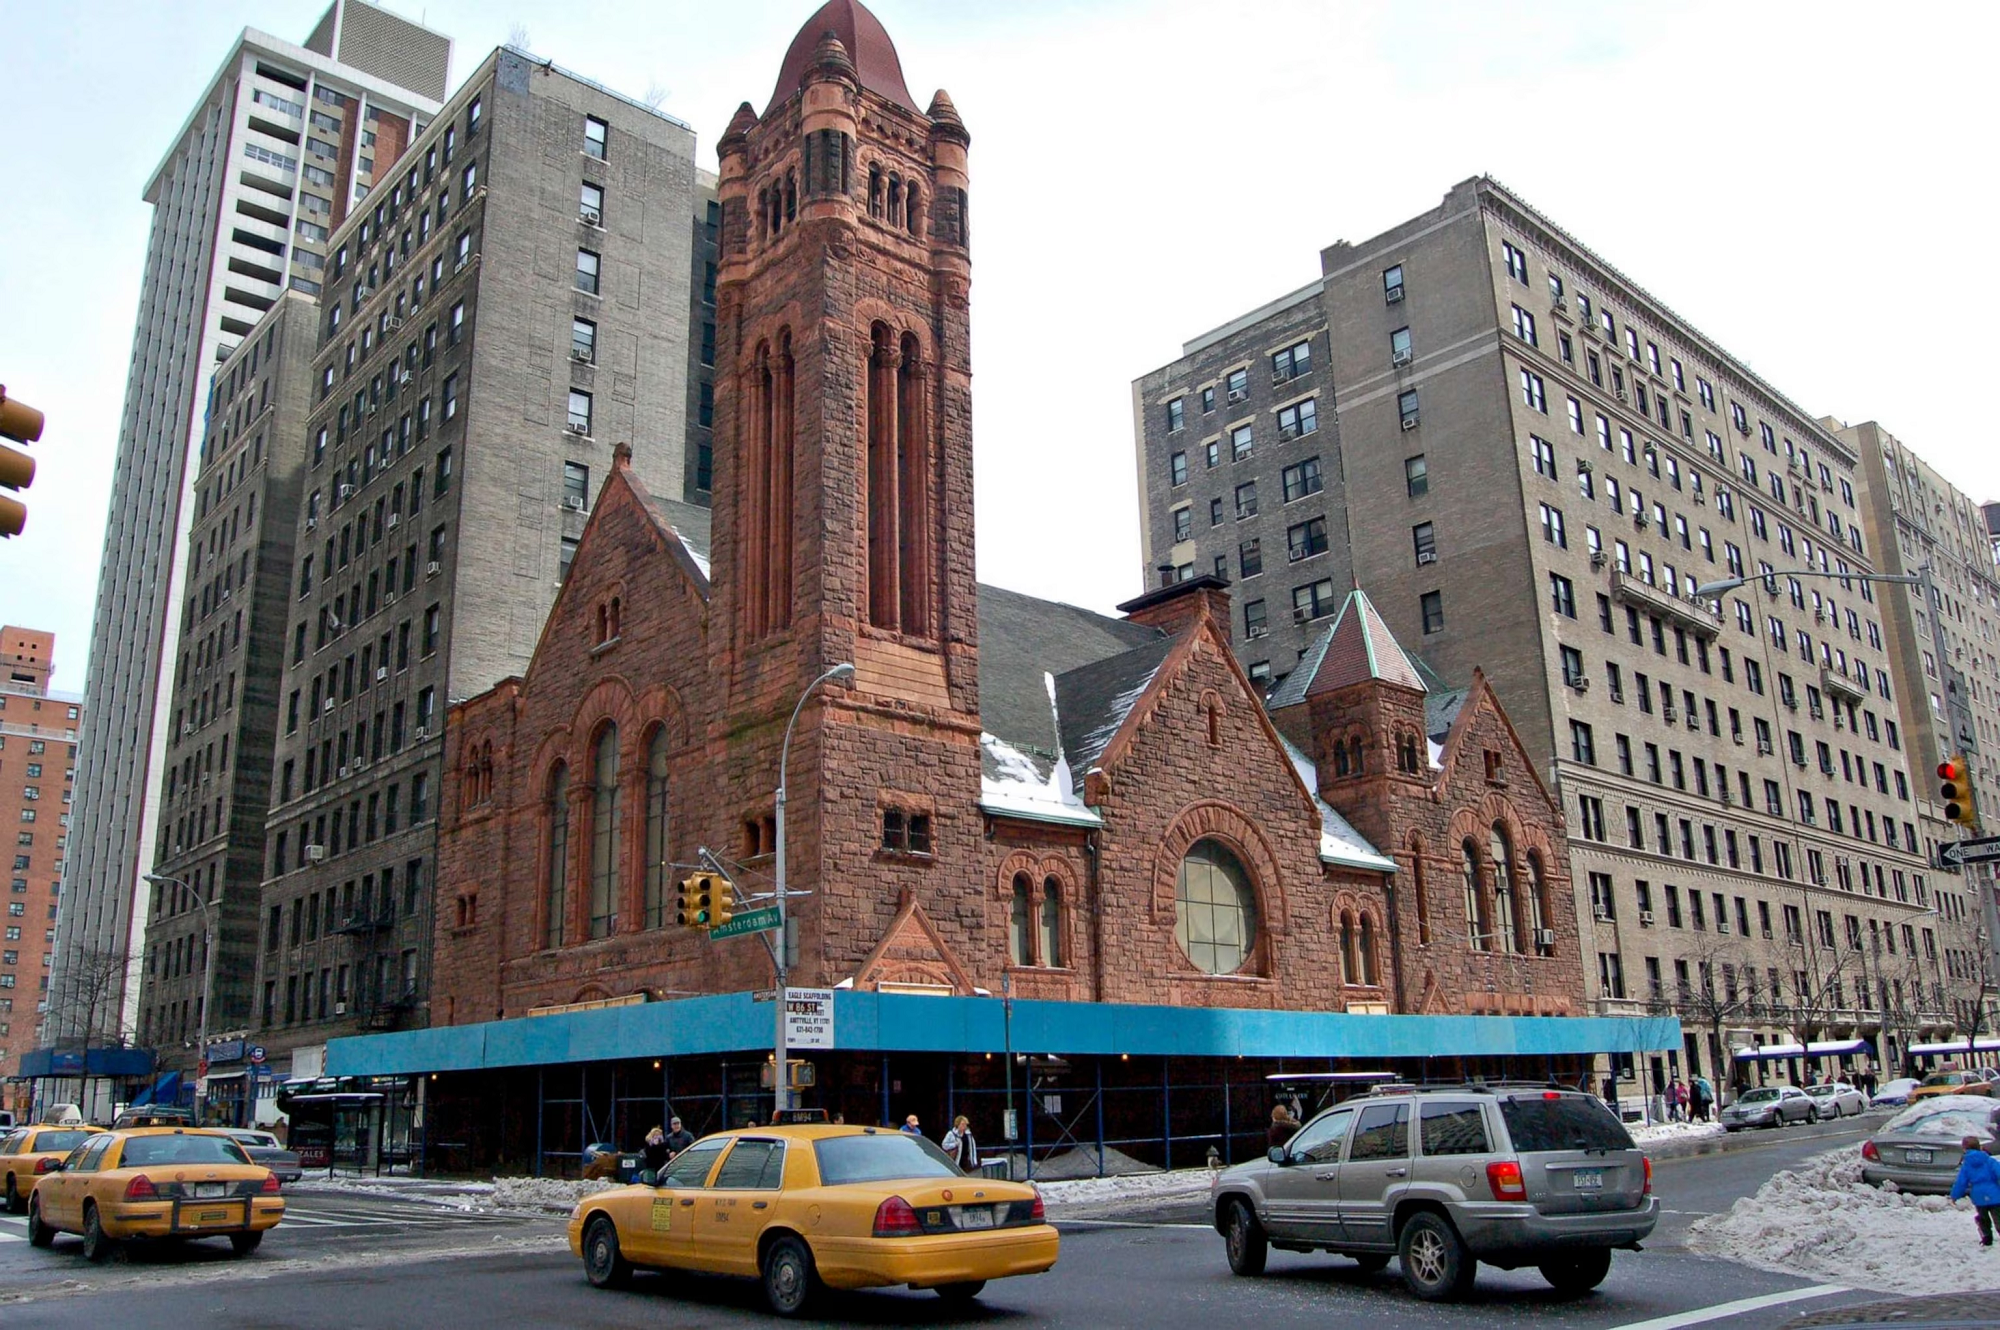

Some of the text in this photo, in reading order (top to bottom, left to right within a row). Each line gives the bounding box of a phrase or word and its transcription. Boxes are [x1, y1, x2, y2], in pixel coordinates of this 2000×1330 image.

[1950, 843, 2000, 858] ONE WA
[713, 911, 779, 935] Amsterdam Av
[804, 992, 832, 1000] SCAFFOLDING
[795, 1002, 805, 1011] 86
[807, 1003, 816, 1012] ST
